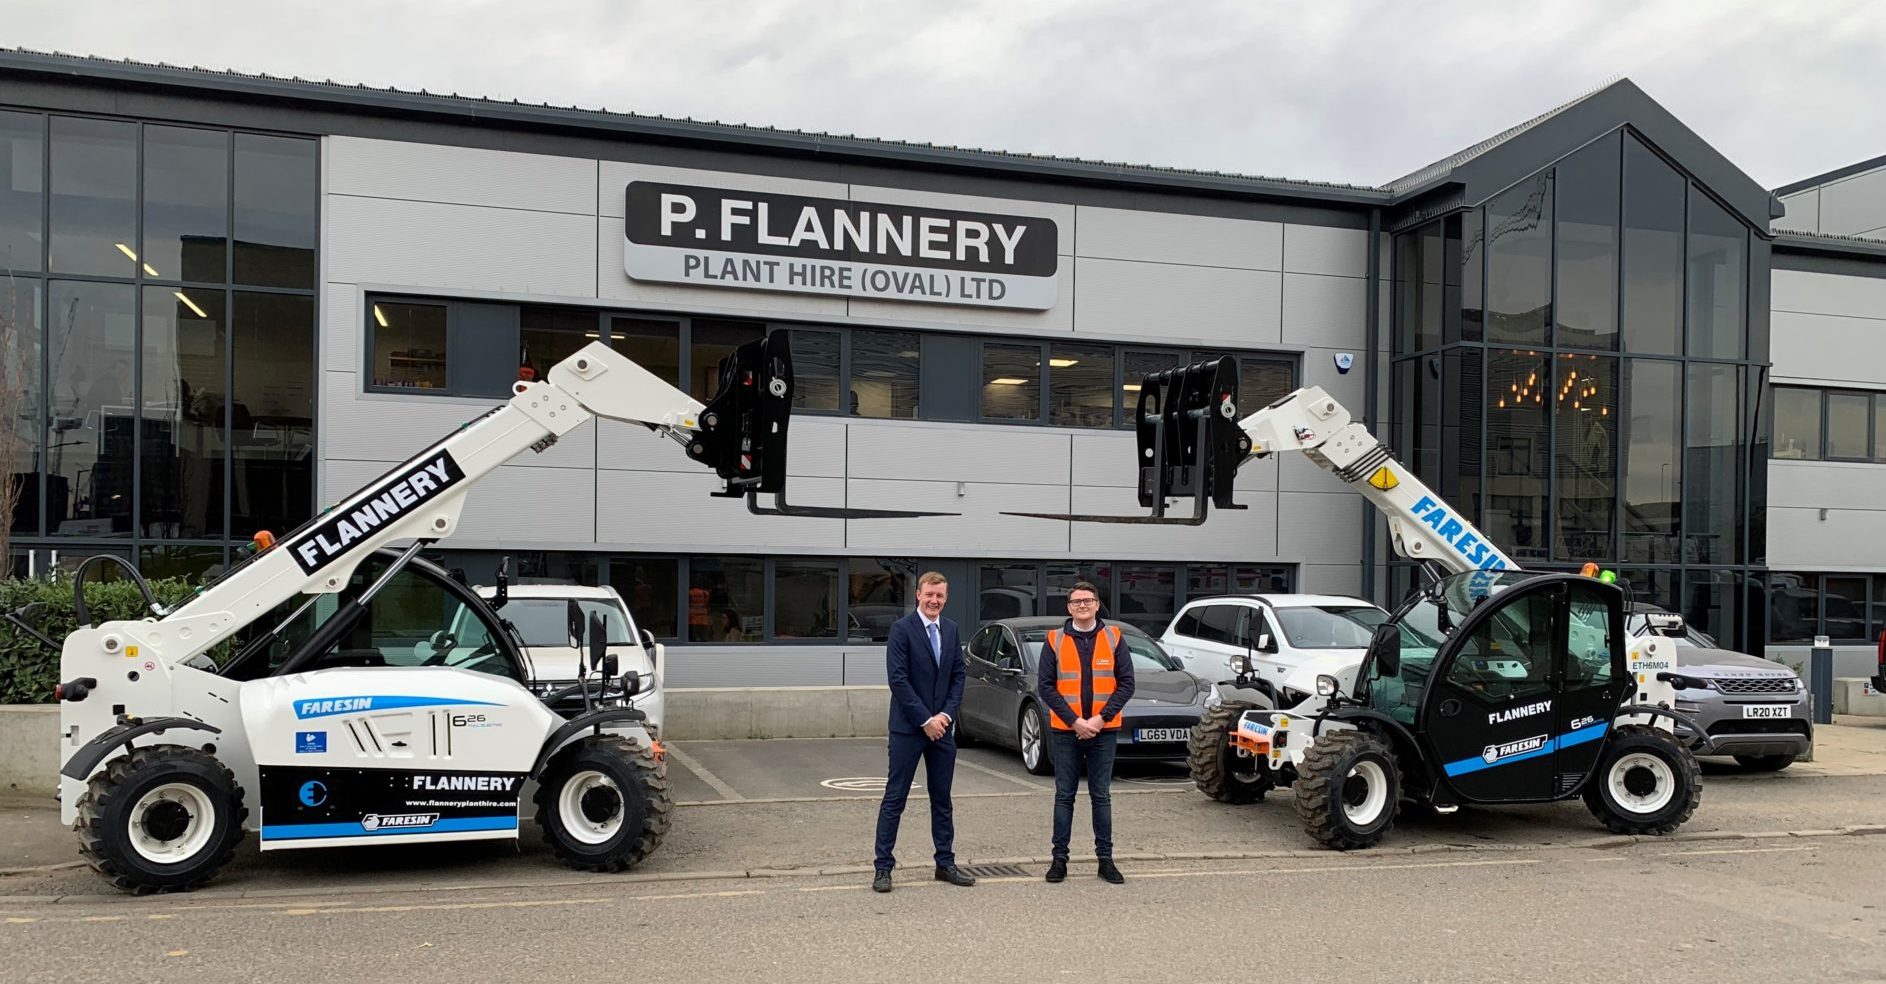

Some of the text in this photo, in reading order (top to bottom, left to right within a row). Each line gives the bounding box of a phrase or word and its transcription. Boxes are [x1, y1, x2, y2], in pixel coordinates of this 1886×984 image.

[660, 193, 1027, 265] P. FLANNERY
[684, 254, 1006, 301] PLANT HIRE (OVAL) LTD
[297, 457, 450, 568] FLANNERY
[1632, 661, 1669, 670] ETH6M04
[301, 698, 372, 715] FARESIN
[1488, 700, 1552, 725] FLANNERY
[1746, 707, 1788, 717] LR20 XZT
[1140, 729, 1188, 740] LG69 VDA
[1243, 721, 1269, 735] FARESIN
[1500, 738, 1540, 756] FARESIN
[412, 775, 515, 791] FLANNERY
[405, 800, 516, 808] www.flanneryplanthire.com
[381, 816, 430, 826] FARESIN
